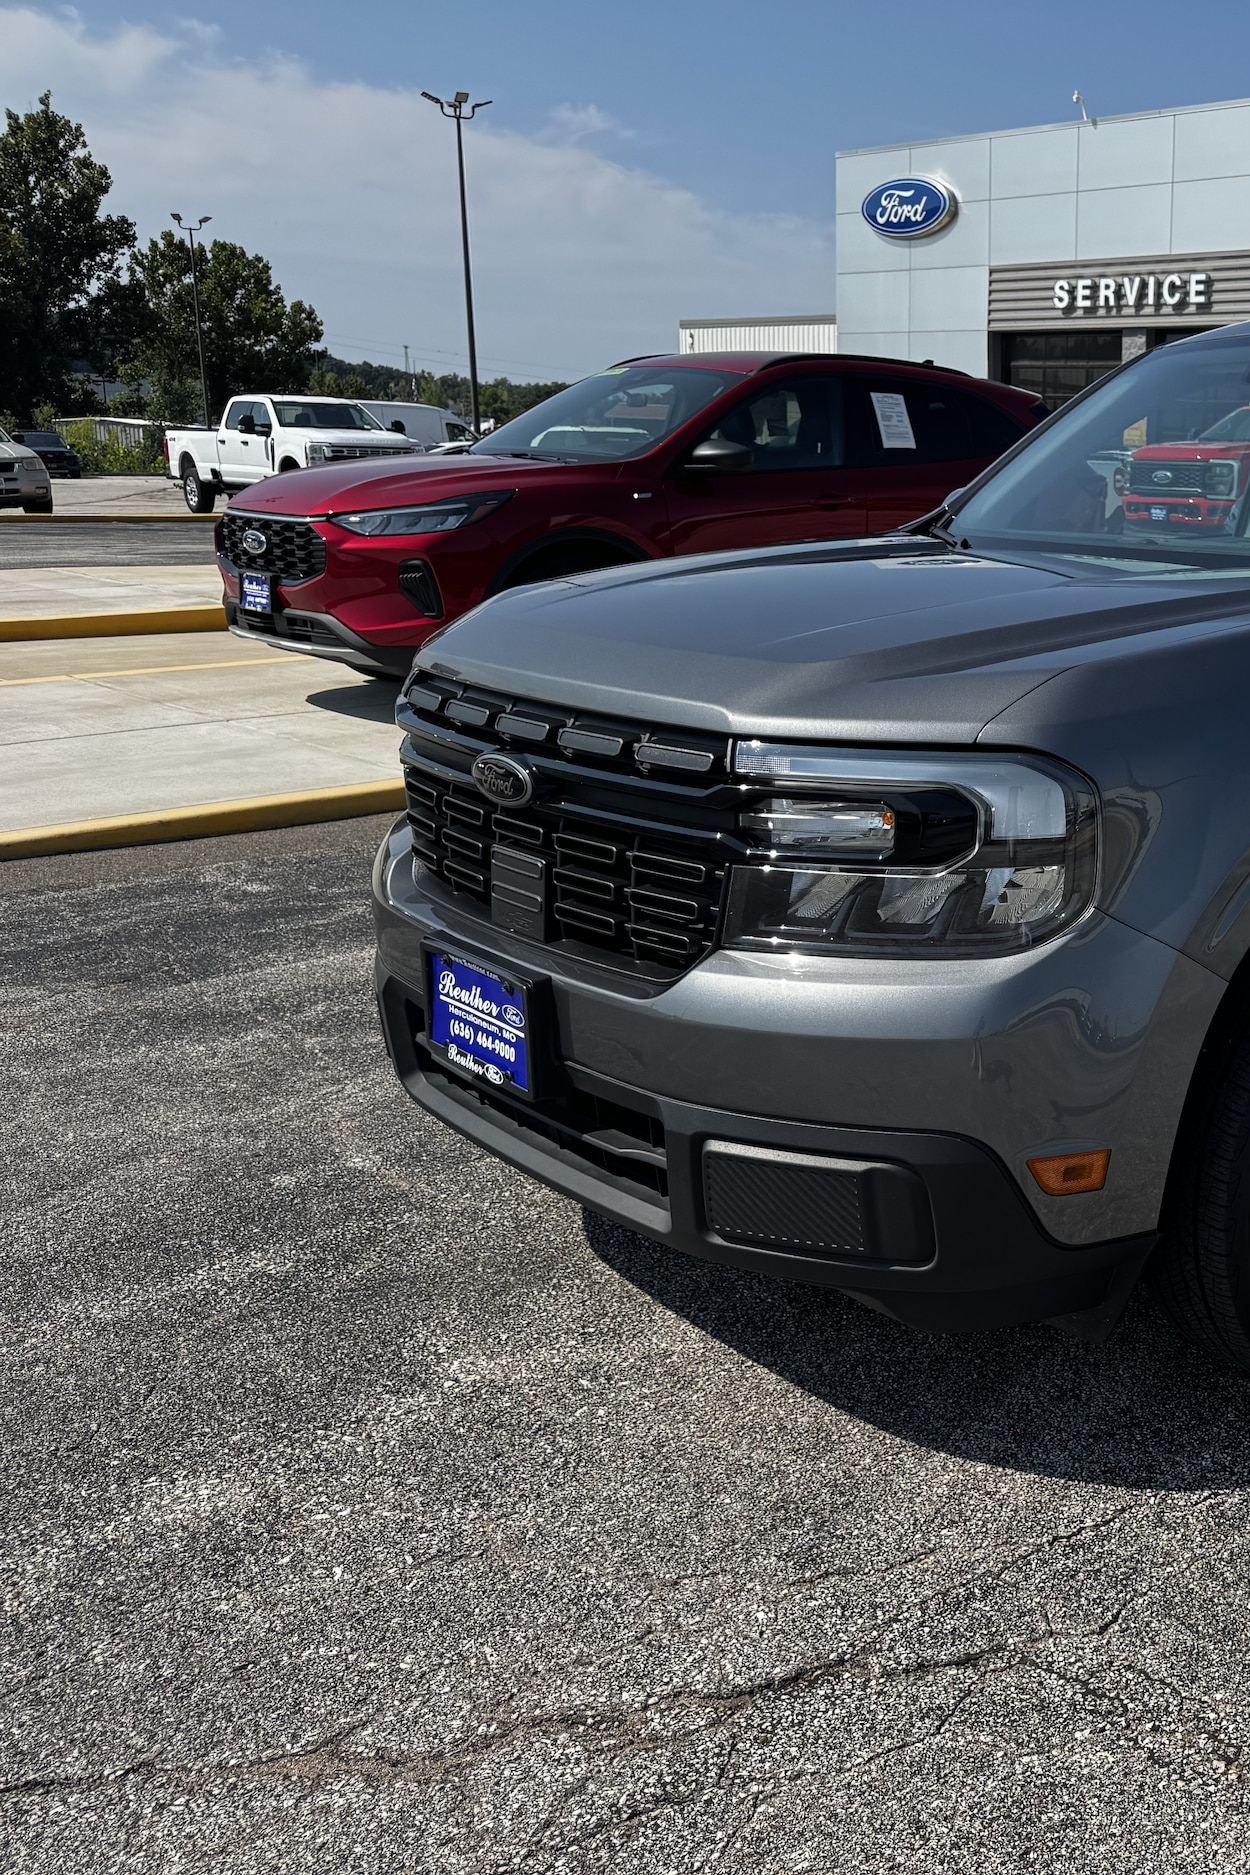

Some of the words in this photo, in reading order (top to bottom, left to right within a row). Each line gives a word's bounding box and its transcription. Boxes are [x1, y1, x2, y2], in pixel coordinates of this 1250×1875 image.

[876, 190, 927, 224] Ford
[1053, 273, 1207, 309] SERVICE
[482, 764, 513, 795] Ford
[438, 970, 501, 1017] Reuther
[448, 1004, 502, 1037] Herculaneum,
[502, 1029, 517, 1043] MO
[449, 1018, 475, 1045] (636)
[476, 1031, 516, 1063] 464-9000
[447, 1043, 485, 1076] Reuther
